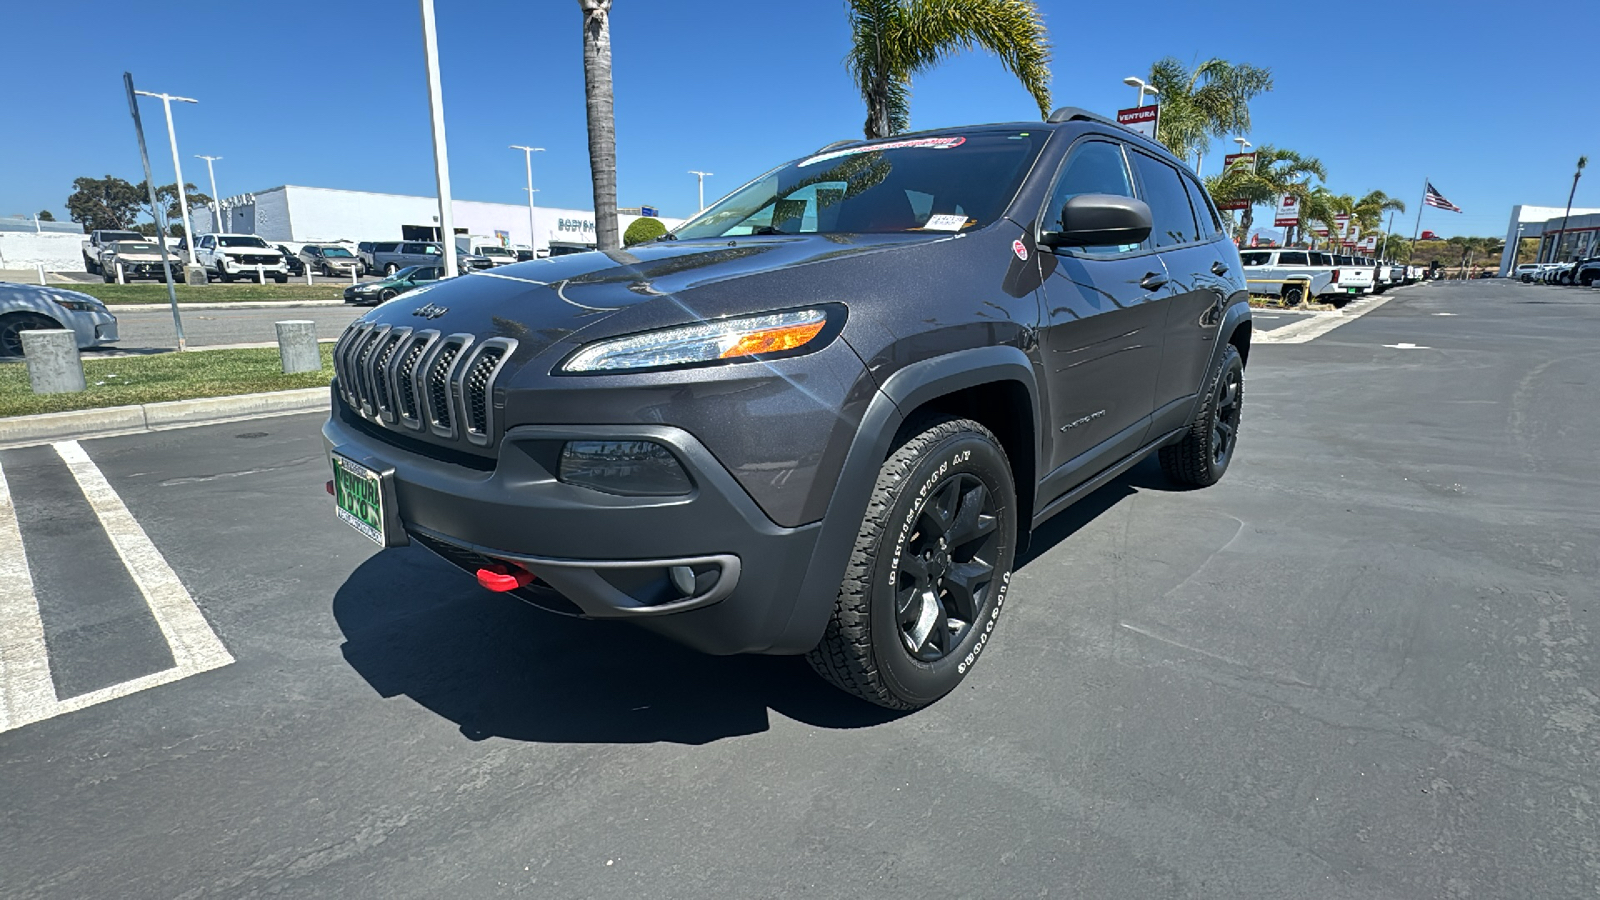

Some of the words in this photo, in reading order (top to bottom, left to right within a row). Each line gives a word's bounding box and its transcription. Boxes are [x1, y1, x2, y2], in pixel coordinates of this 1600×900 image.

[1119, 110, 1155, 121] VENTURA
[339, 470, 381, 506] VENTURA
[888, 460, 948, 586] DESTINATION
[952, 449, 971, 466] A/T
